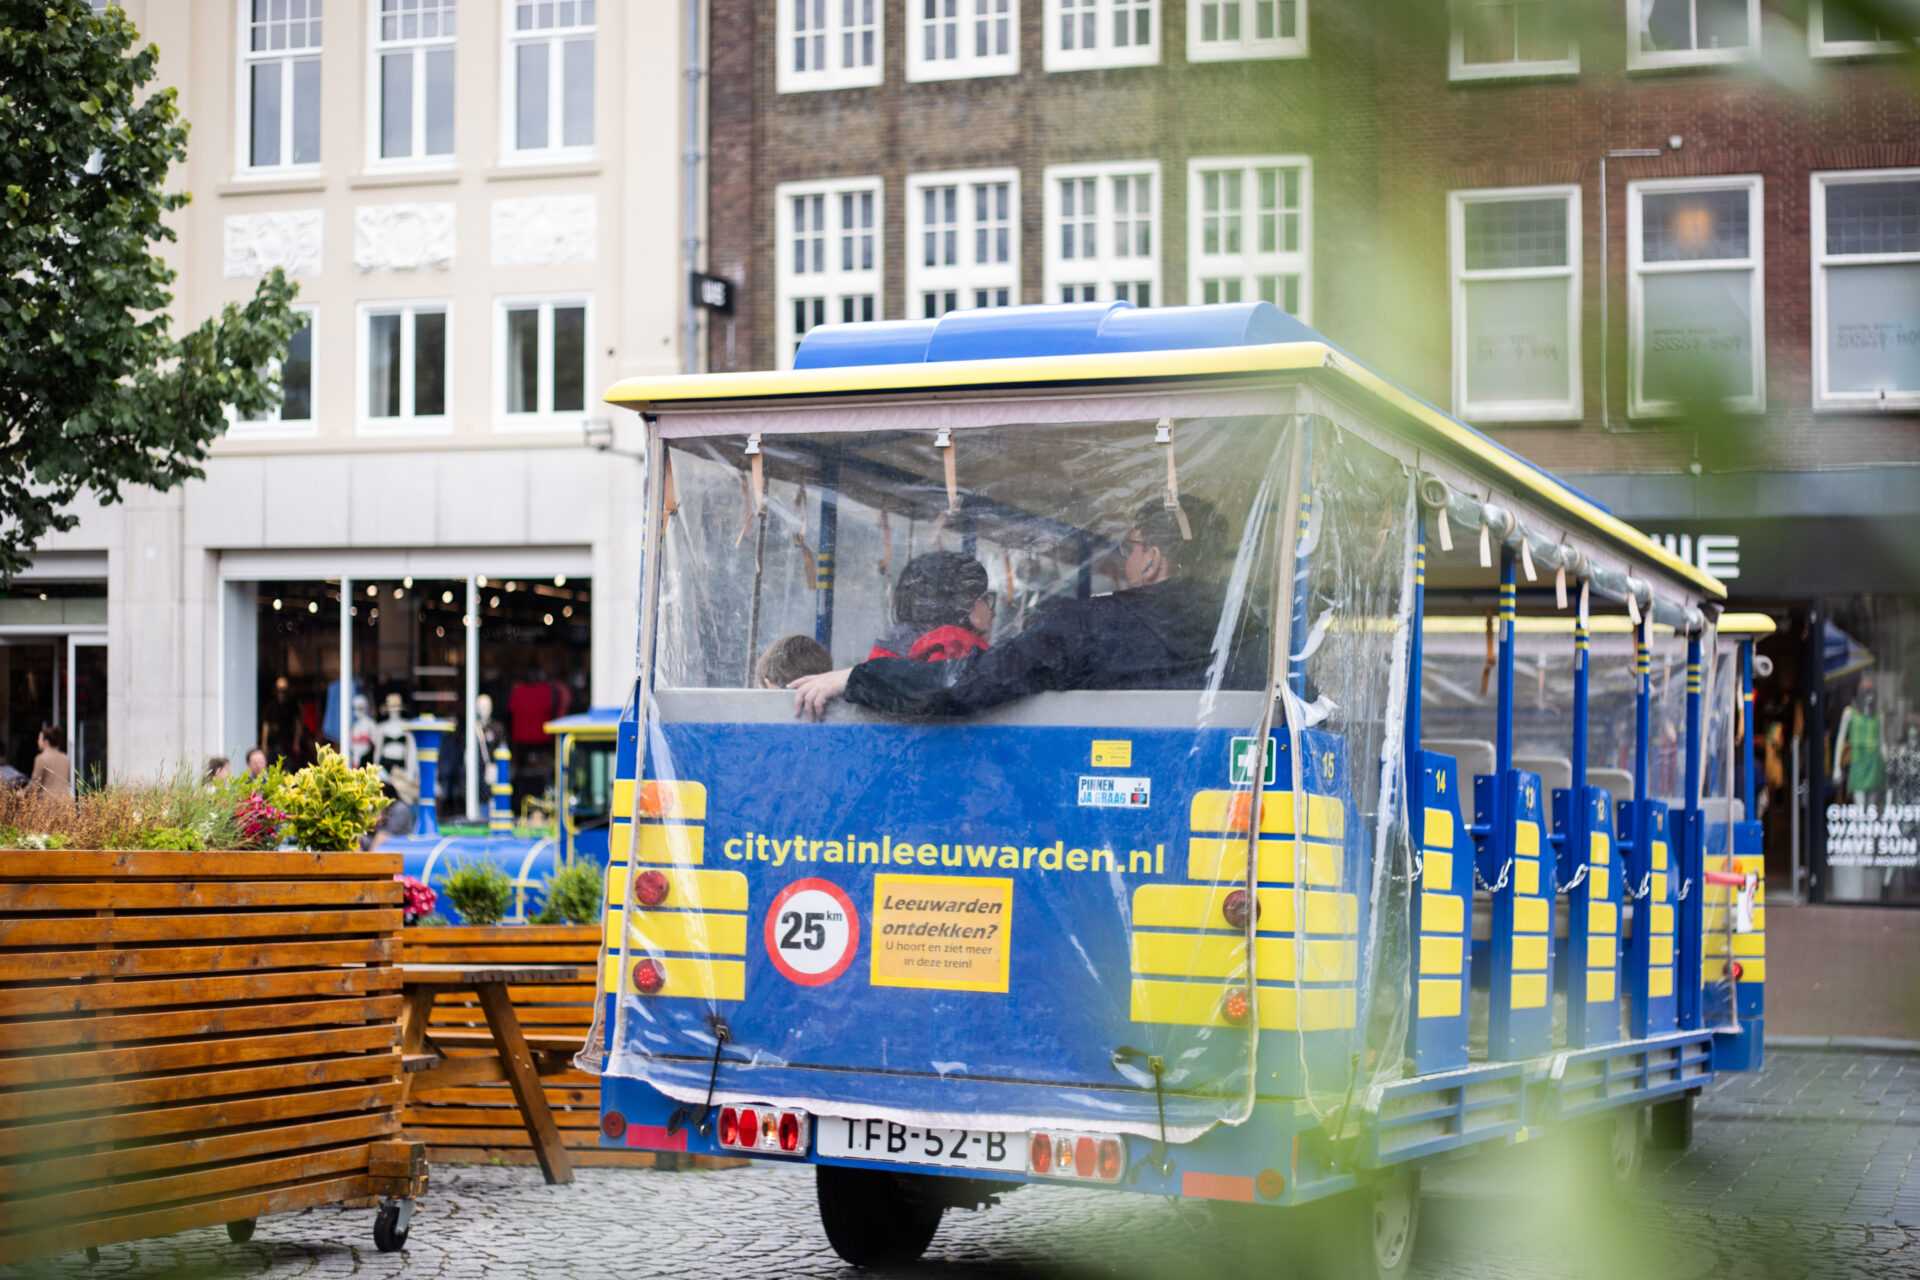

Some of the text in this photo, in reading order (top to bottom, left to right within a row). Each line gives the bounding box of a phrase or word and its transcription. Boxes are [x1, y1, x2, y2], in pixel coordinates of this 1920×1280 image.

[1322, 752, 1335, 778] 15
[1081, 778, 1115, 791] PINNEN
[1435, 769, 1446, 793] 14
[1080, 791, 1127, 804] JA GRAAG
[723, 832, 1165, 874] citytrainleeuwarden.nl
[883, 895, 1003, 914] Leeuwarden
[780, 911, 843, 951] 25 km
[882, 922, 999, 939] ontdekken?
[886, 941, 993, 954] U hoort en ziet meer
[904, 956, 972, 968] in deze trein!
[842, 1117, 1007, 1161] TFB-52-B
